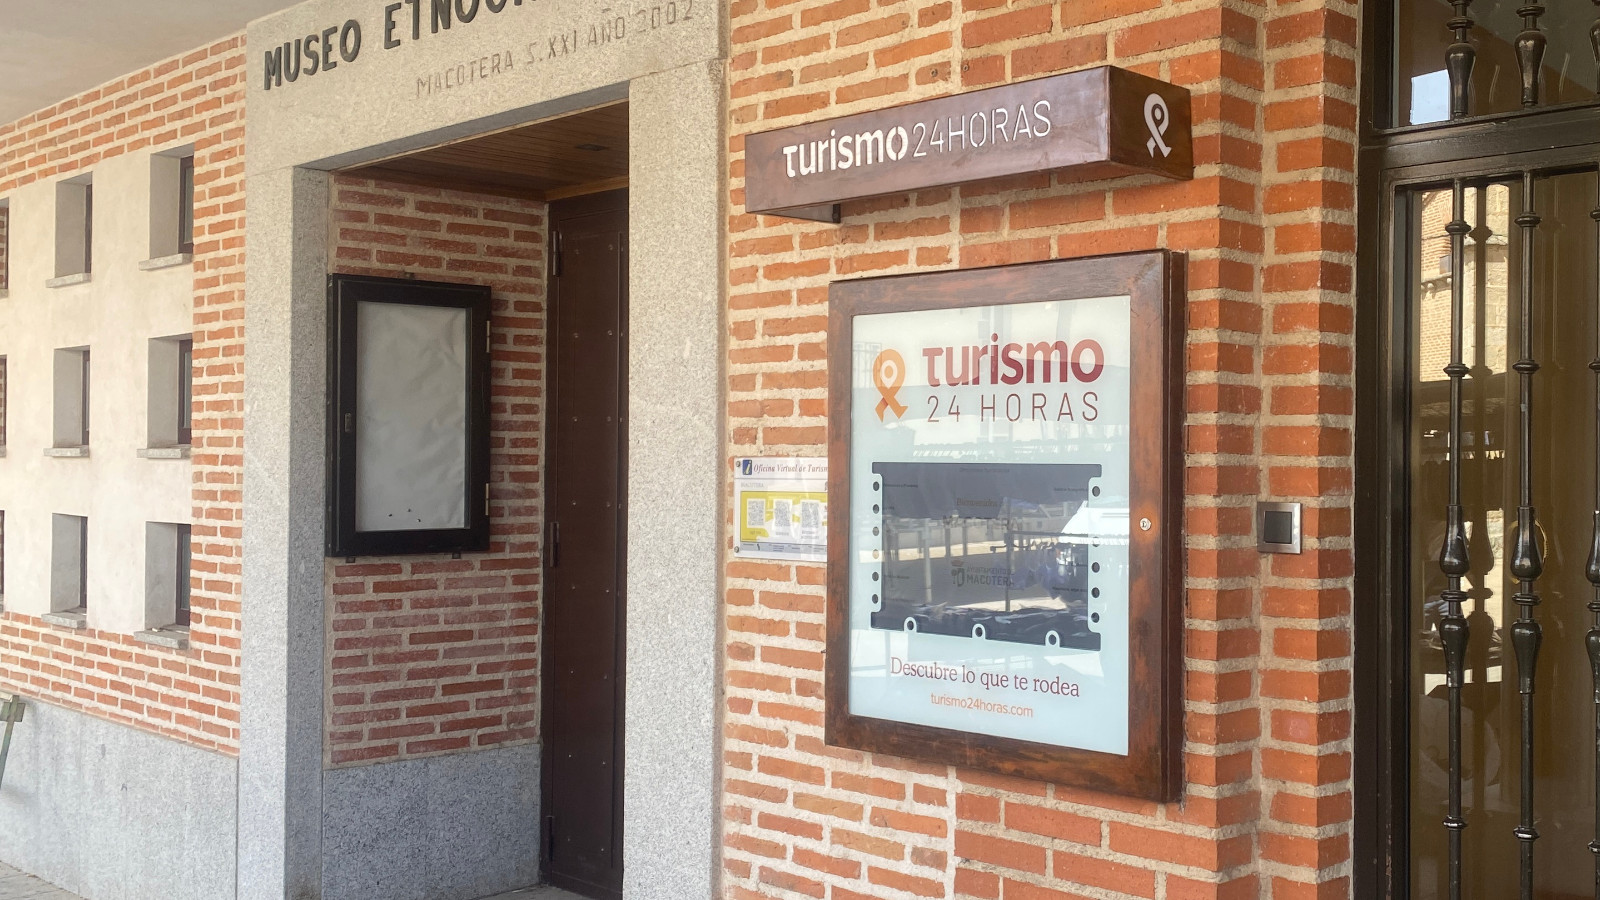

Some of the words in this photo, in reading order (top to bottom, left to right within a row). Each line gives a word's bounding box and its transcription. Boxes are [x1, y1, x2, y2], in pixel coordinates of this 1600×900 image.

[263, 19, 361, 91] MUSEO
[416, 50, 514, 97] MACOTERA
[636, 0, 694, 33] 2002
[922, 332, 1105, 387] turismo
[927, 395, 961, 422] 24
[981, 391, 1098, 422] HORAS
[753, 464, 775, 475] Oficina
[776, 464, 798, 473] Virtual
[807, 464, 828, 473] Turism
[890, 656, 958, 681] Descubre
[962, 665, 976, 683] lo
[980, 672, 1009, 690] que
[1014, 674, 1028, 690] te
[1033, 676, 1080, 697] rodea
[931, 692, 1034, 717] turismo24horas.com
